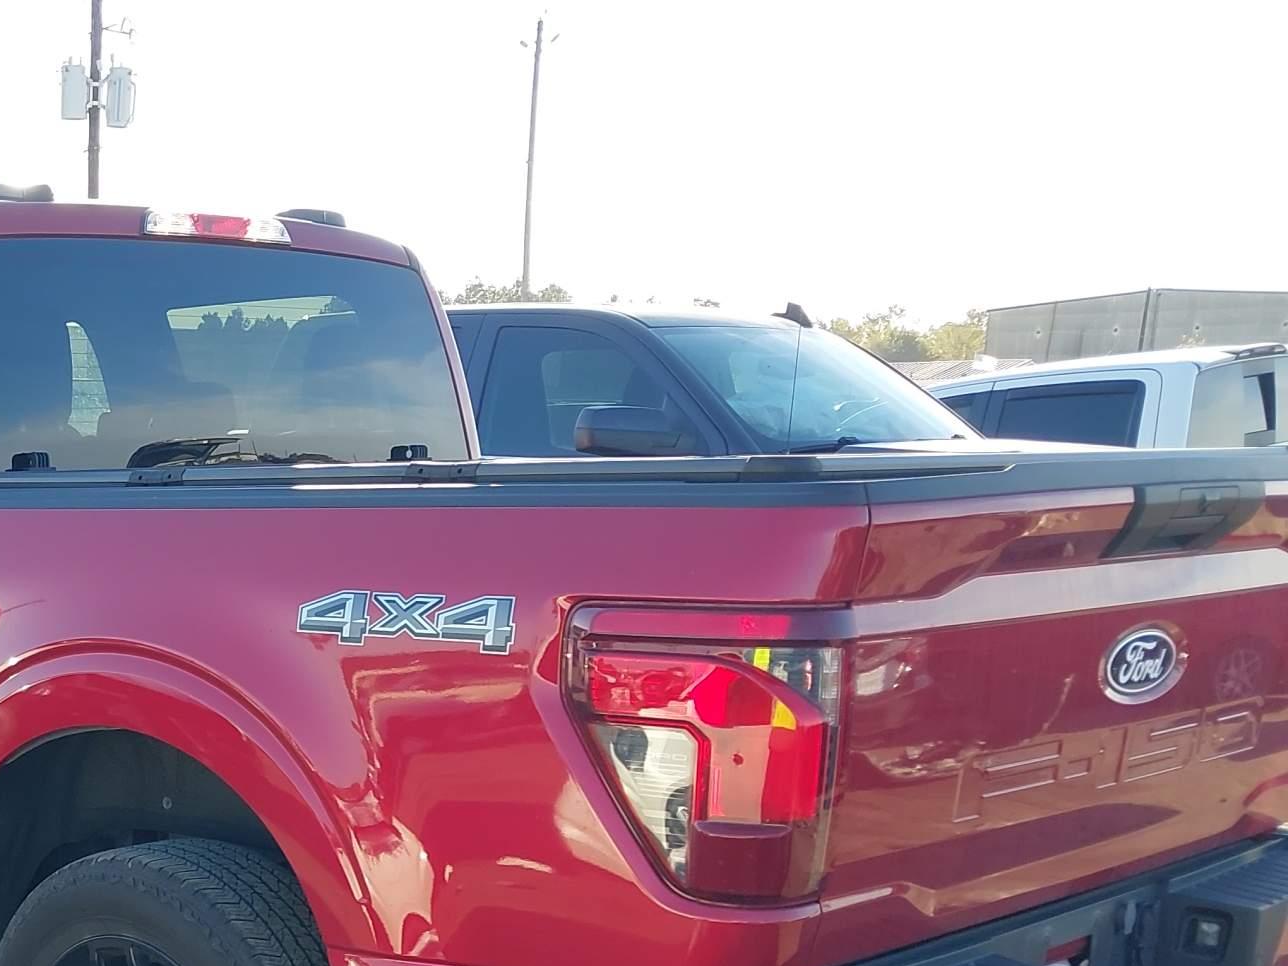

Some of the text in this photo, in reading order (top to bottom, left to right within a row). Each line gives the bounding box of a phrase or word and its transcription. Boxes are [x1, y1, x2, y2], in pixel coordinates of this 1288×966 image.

[297, 590, 516, 655] 4X4
[1119, 641, 1167, 684] Ford
[951, 697, 1264, 824] F-150
